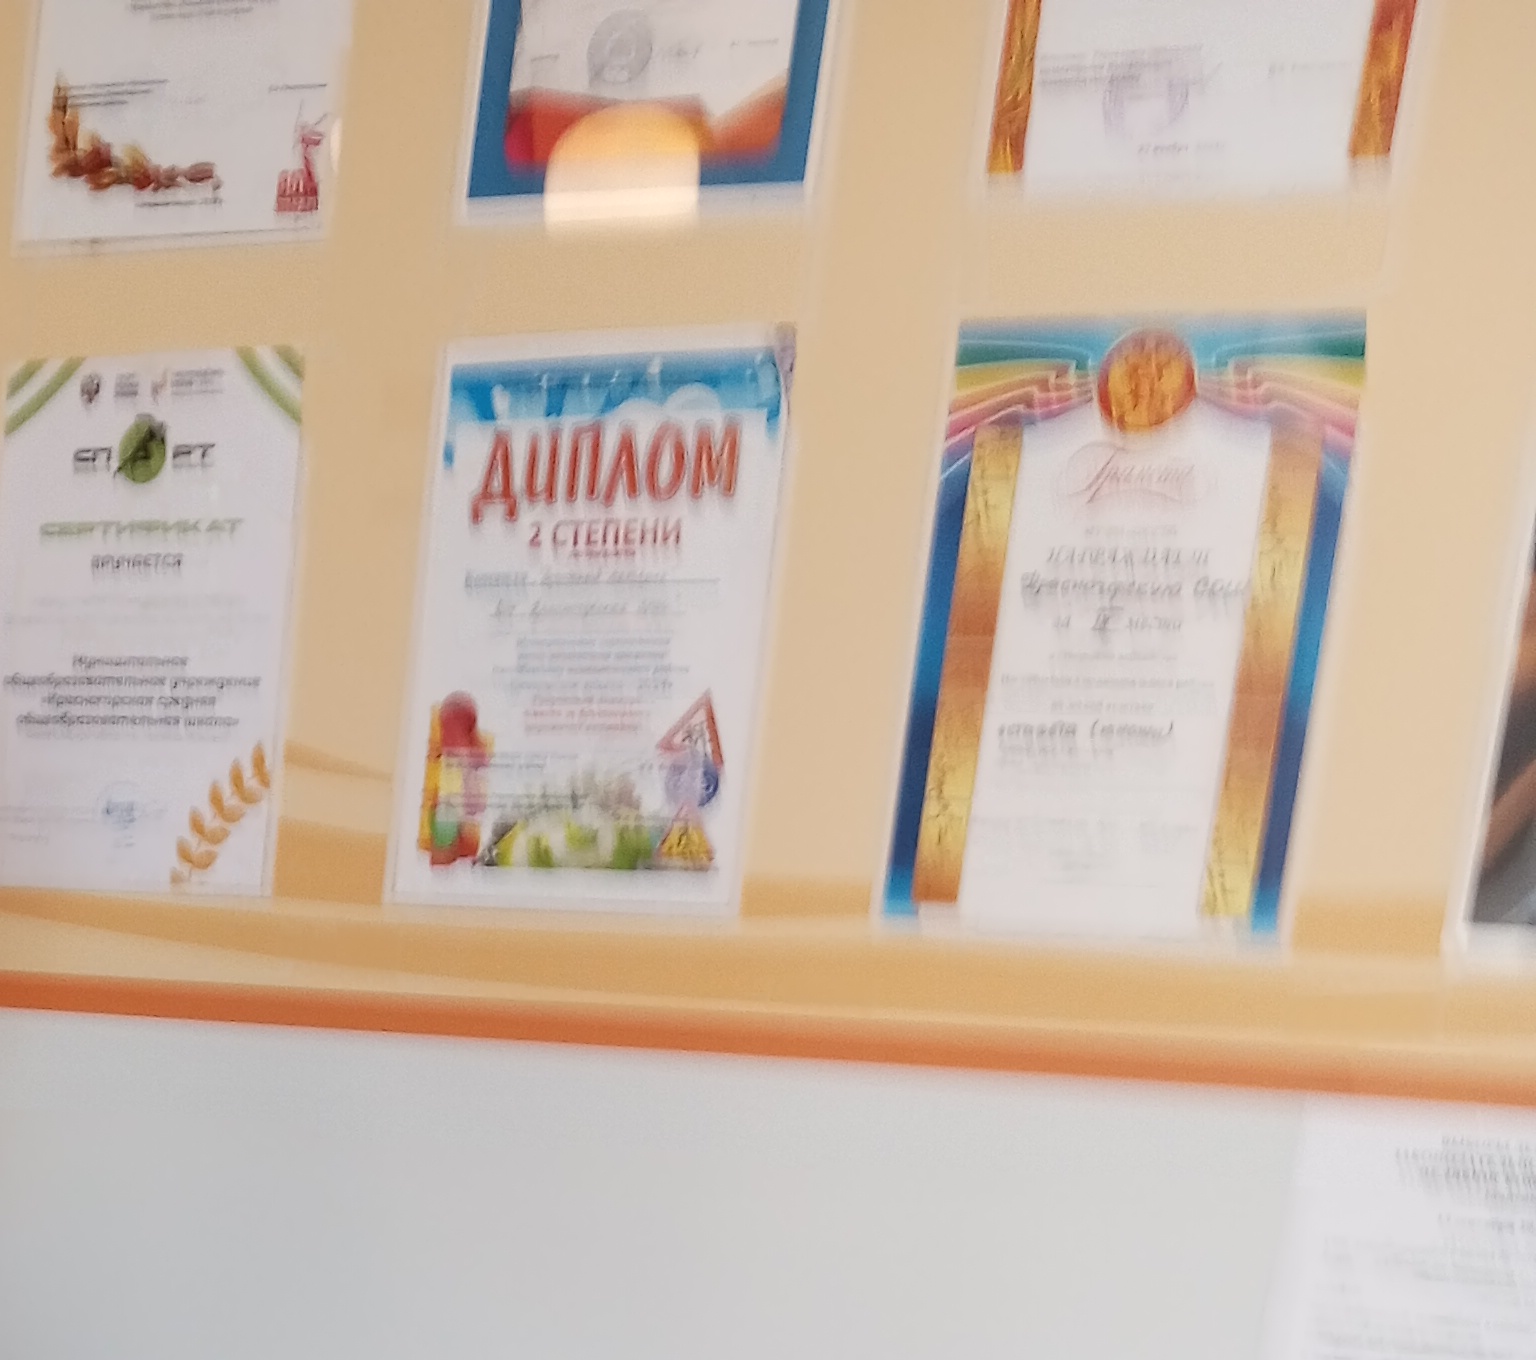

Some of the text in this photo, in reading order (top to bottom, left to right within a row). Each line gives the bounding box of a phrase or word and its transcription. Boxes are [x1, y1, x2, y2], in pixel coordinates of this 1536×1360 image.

[470, 416, 741, 525] ДИПЛОМ
[528, 517, 682, 549] 2 СТЕПЕНИ
